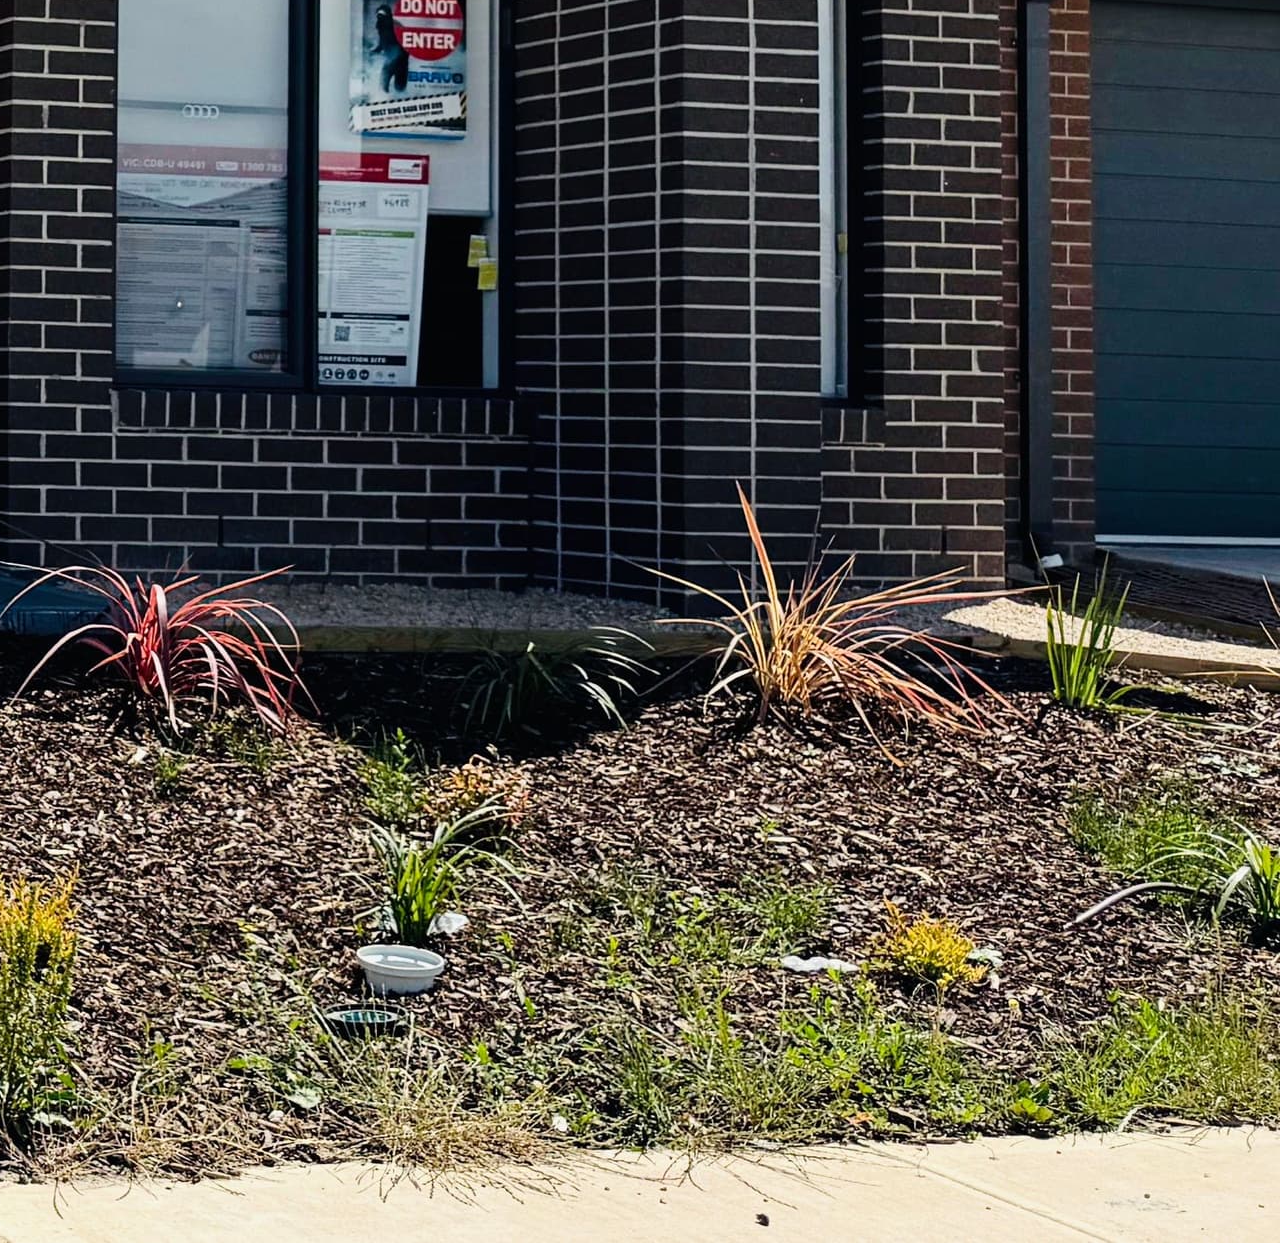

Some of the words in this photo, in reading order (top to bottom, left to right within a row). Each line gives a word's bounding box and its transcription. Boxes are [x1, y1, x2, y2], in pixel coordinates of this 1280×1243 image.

[425, 0, 458, 15] NOT
[402, 32, 455, 50] ENTER
[407, 71, 464, 84] BRAVO
